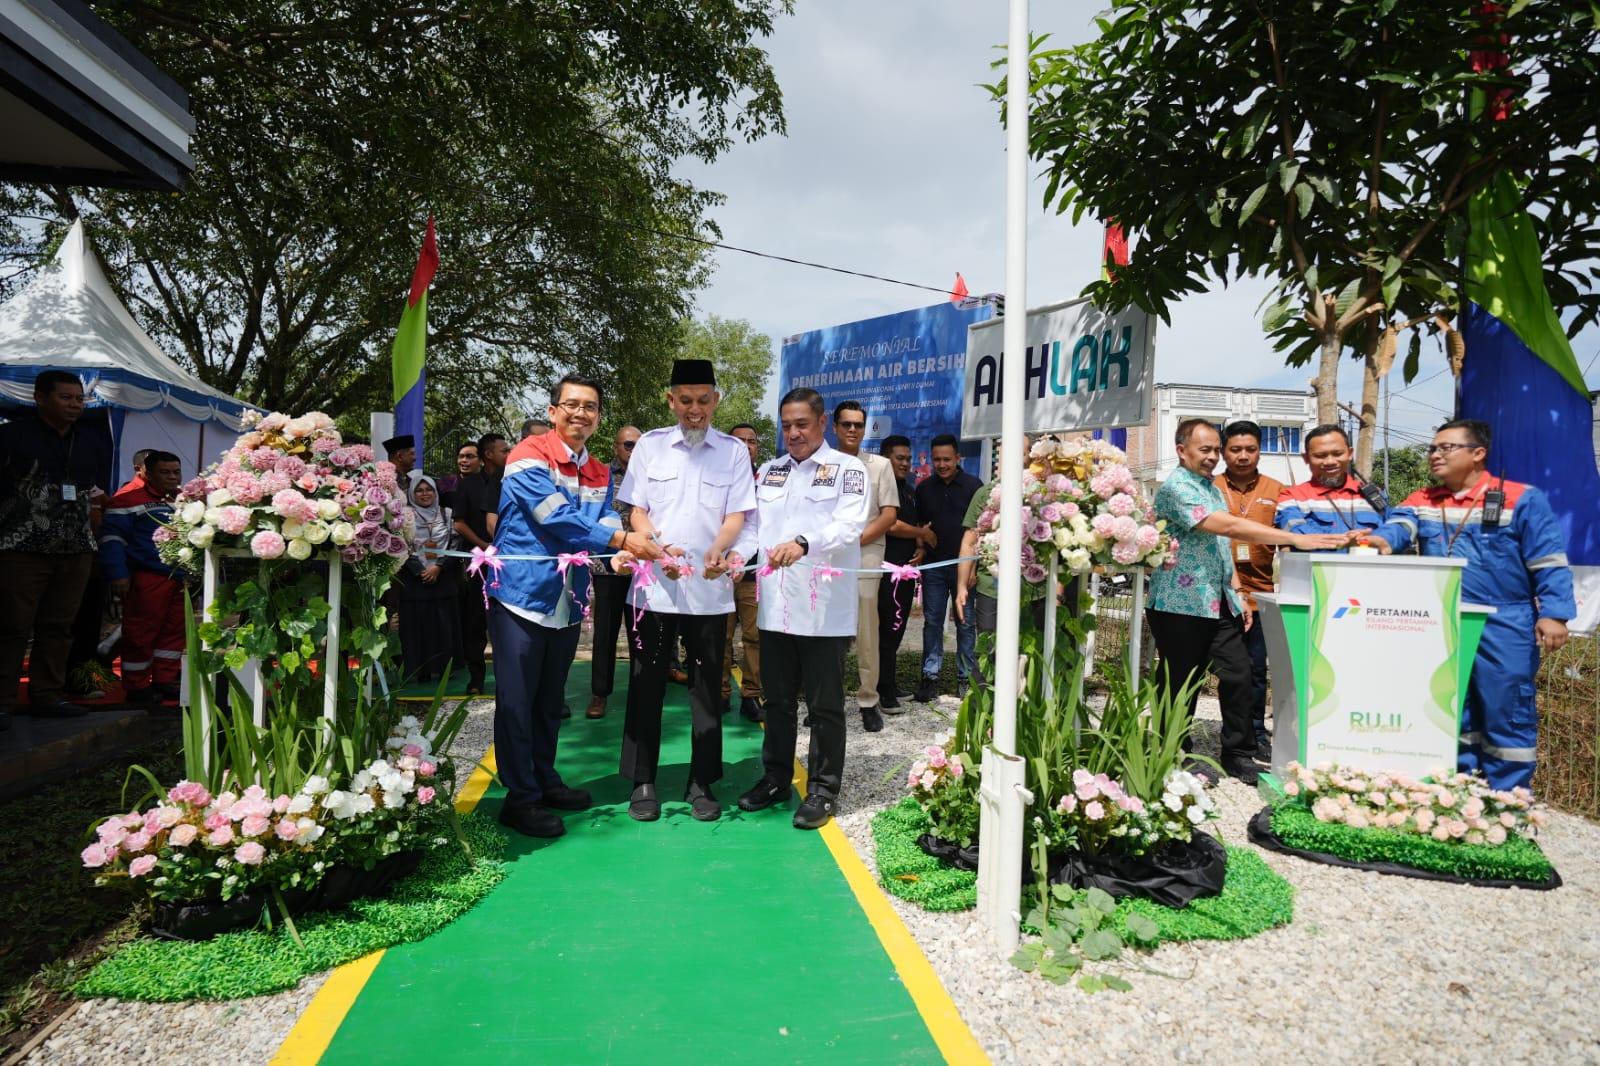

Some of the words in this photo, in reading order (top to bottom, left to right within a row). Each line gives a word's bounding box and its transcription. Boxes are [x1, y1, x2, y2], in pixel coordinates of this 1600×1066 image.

[823, 335, 921, 365] SEREMONIAL
[792, 366, 875, 389] PENERIMAAN
[877, 362, 903, 379] AIR
[907, 352, 966, 375] BERSIH
[973, 325, 1132, 407] AHLAK
[1366, 607, 1430, 618] PERTAMINA
[1395, 618, 1438, 626] PERTAMINA
[1365, 623, 1426, 632] INTERNASIONAL
